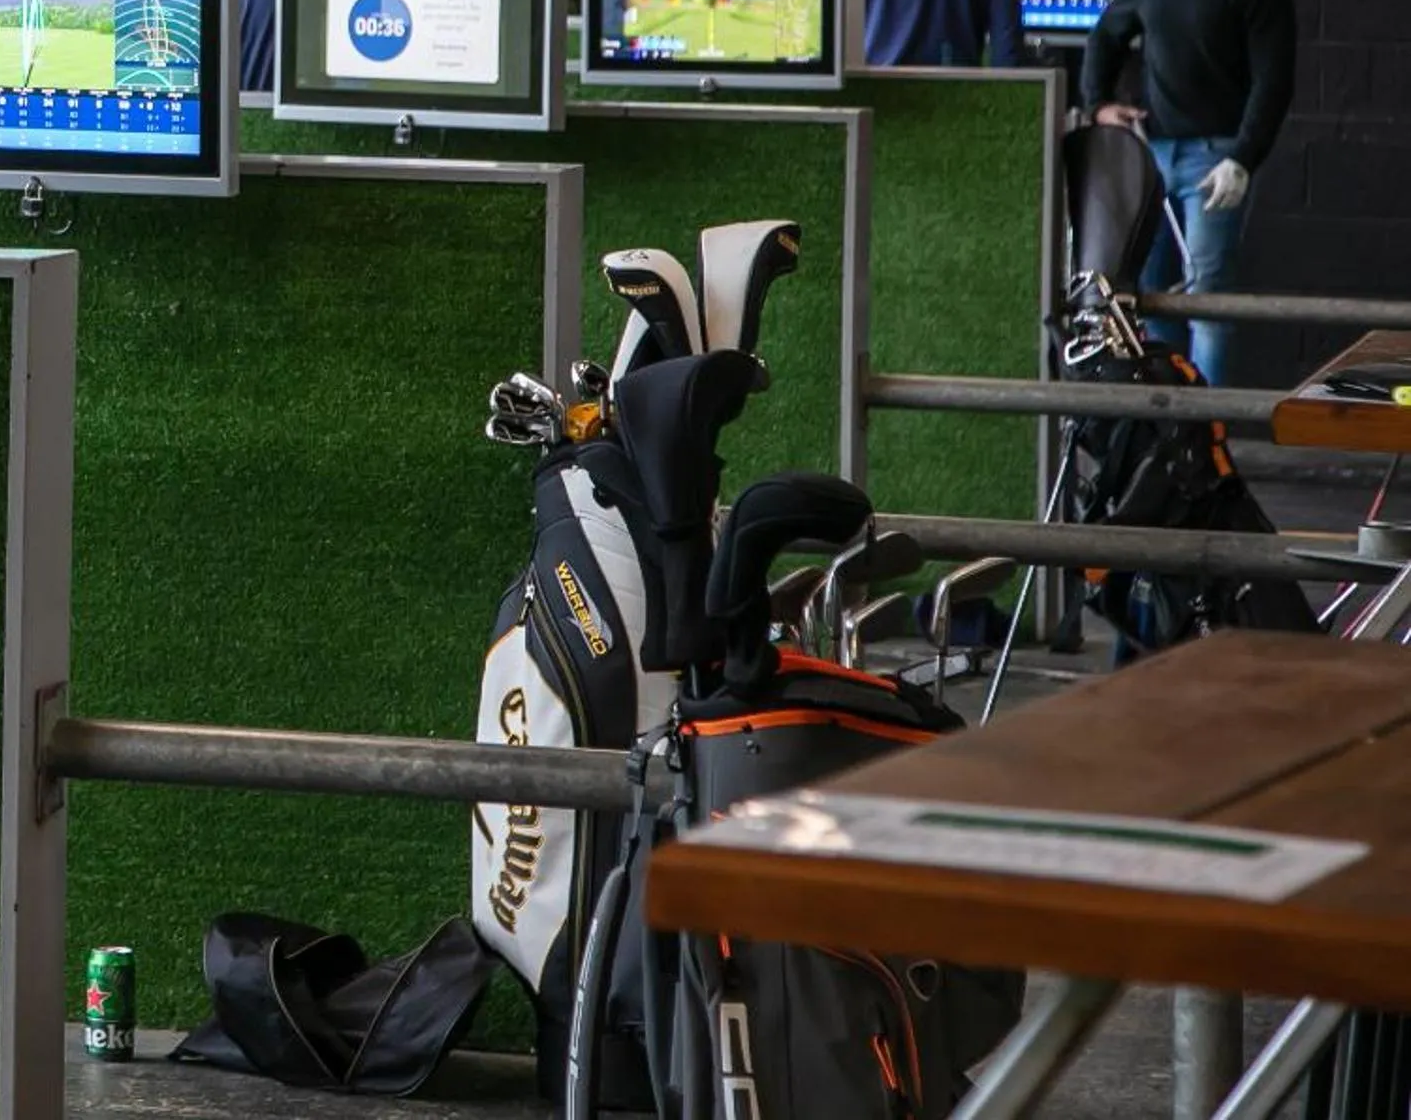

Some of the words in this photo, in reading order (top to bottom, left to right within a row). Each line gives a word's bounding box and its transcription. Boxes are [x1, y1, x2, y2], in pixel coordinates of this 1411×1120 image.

[355, 16, 406, 37] 00:36
[557, 560, 607, 655] WARBIRD
[487, 686, 544, 935] Caaway
